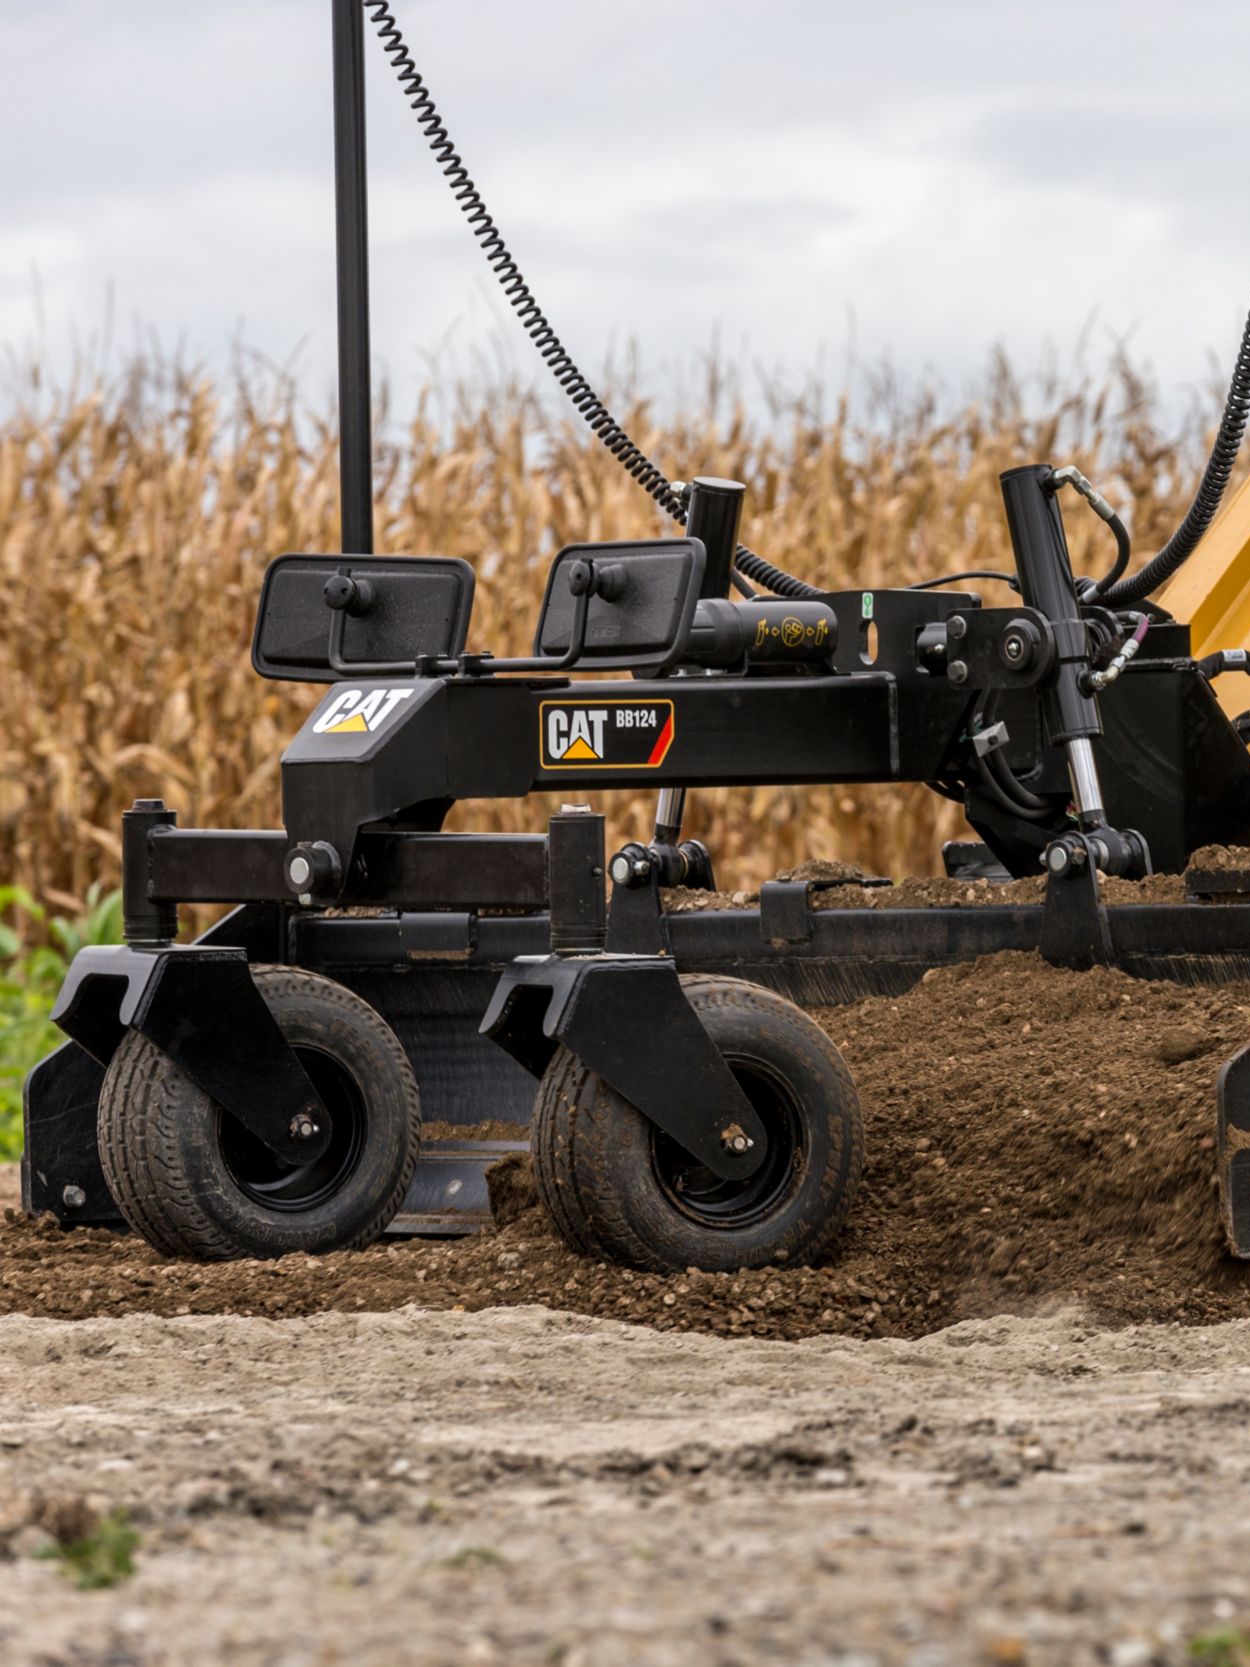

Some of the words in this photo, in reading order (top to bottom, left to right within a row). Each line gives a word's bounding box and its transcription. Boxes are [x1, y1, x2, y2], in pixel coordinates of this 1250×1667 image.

[312, 688, 415, 733] CAT
[547, 709, 608, 759] CAT
[615, 709, 657, 728] BB124
